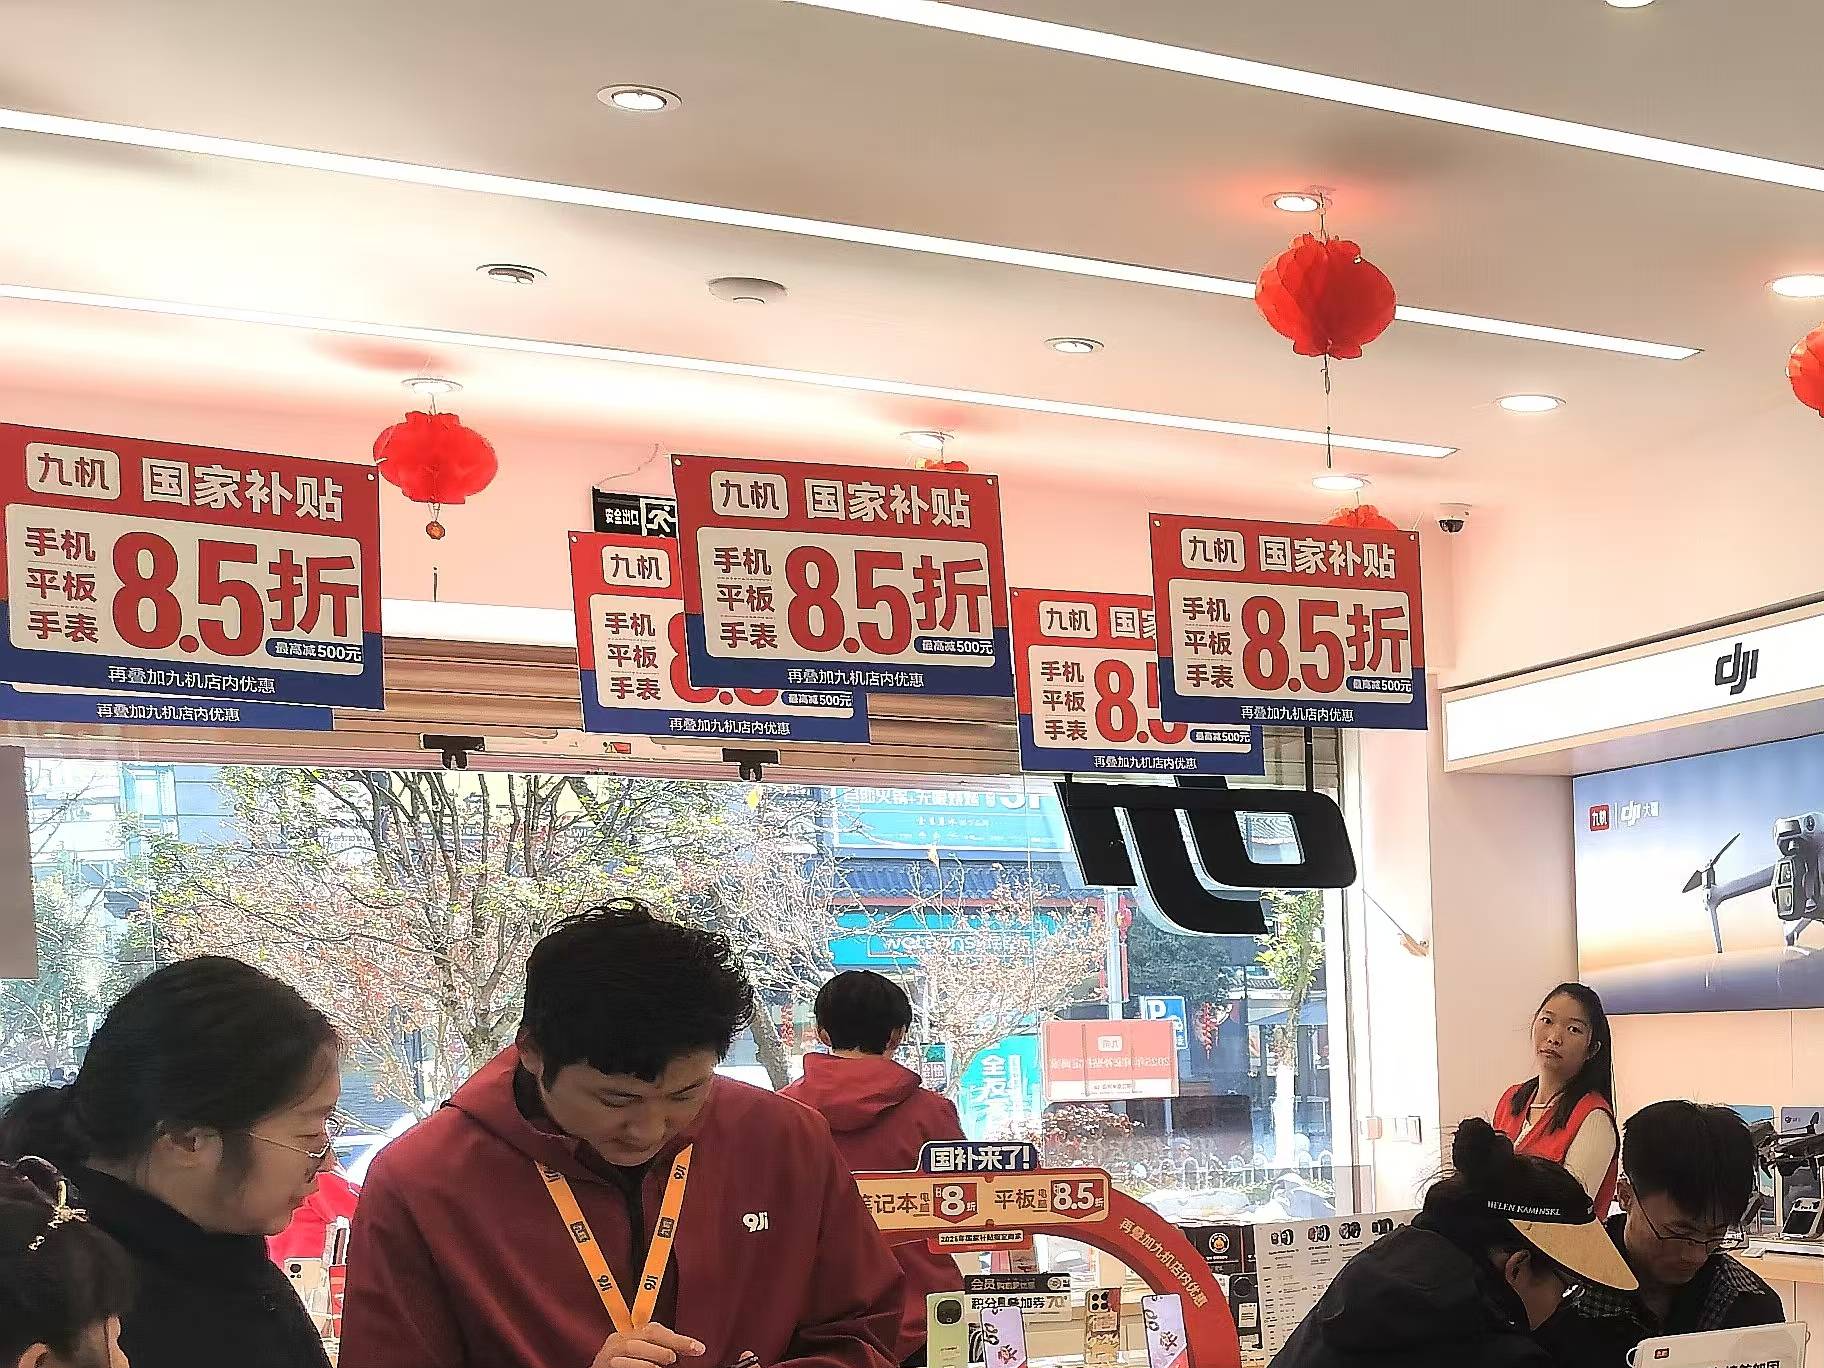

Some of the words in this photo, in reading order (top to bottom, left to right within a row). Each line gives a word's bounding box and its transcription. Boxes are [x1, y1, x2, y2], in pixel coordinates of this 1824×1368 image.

[36, 453, 110, 492] 九机
[141, 456, 344, 523] 国家补贴
[719, 479, 781, 511] 九机
[804, 478, 972, 529] 国家补贴
[25, 527, 97, 564] 手机
[1188, 536, 1238, 566] 九机
[1258, 535, 1396, 579] 国家补贴
[609, 552, 664, 582] 九机
[712, 546, 773, 576] 手机
[26, 568, 98, 605] 平板
[716, 583, 775, 614] 平板
[1045, 608, 1092, 633] 九机
[1182, 597, 1231, 623] 手机
[27, 610, 99, 645] 手表
[604, 612, 656, 638] 手机
[720, 621, 779, 651] 手表
[273, 640, 363, 664] 最高减500元
[606, 643, 660, 670] 平板
[1184, 630, 1233, 656] 平板
[107, 665, 276, 696] 再叠加九机店内优惠
[787, 667, 925, 689] 再叠加九机店内优惠
[1040, 660, 1085, 684] 手机
[1186, 663, 1235, 690] 手表
[609, 675, 663, 701] 手表
[1042, 690, 1087, 713] 平板
[1044, 719, 1089, 741] 手表
[1148, 1000, 1167, 1019] P
[930, 1145, 1030, 1172] 国补来了!
[994, 1188, 1036, 1210] 平板
